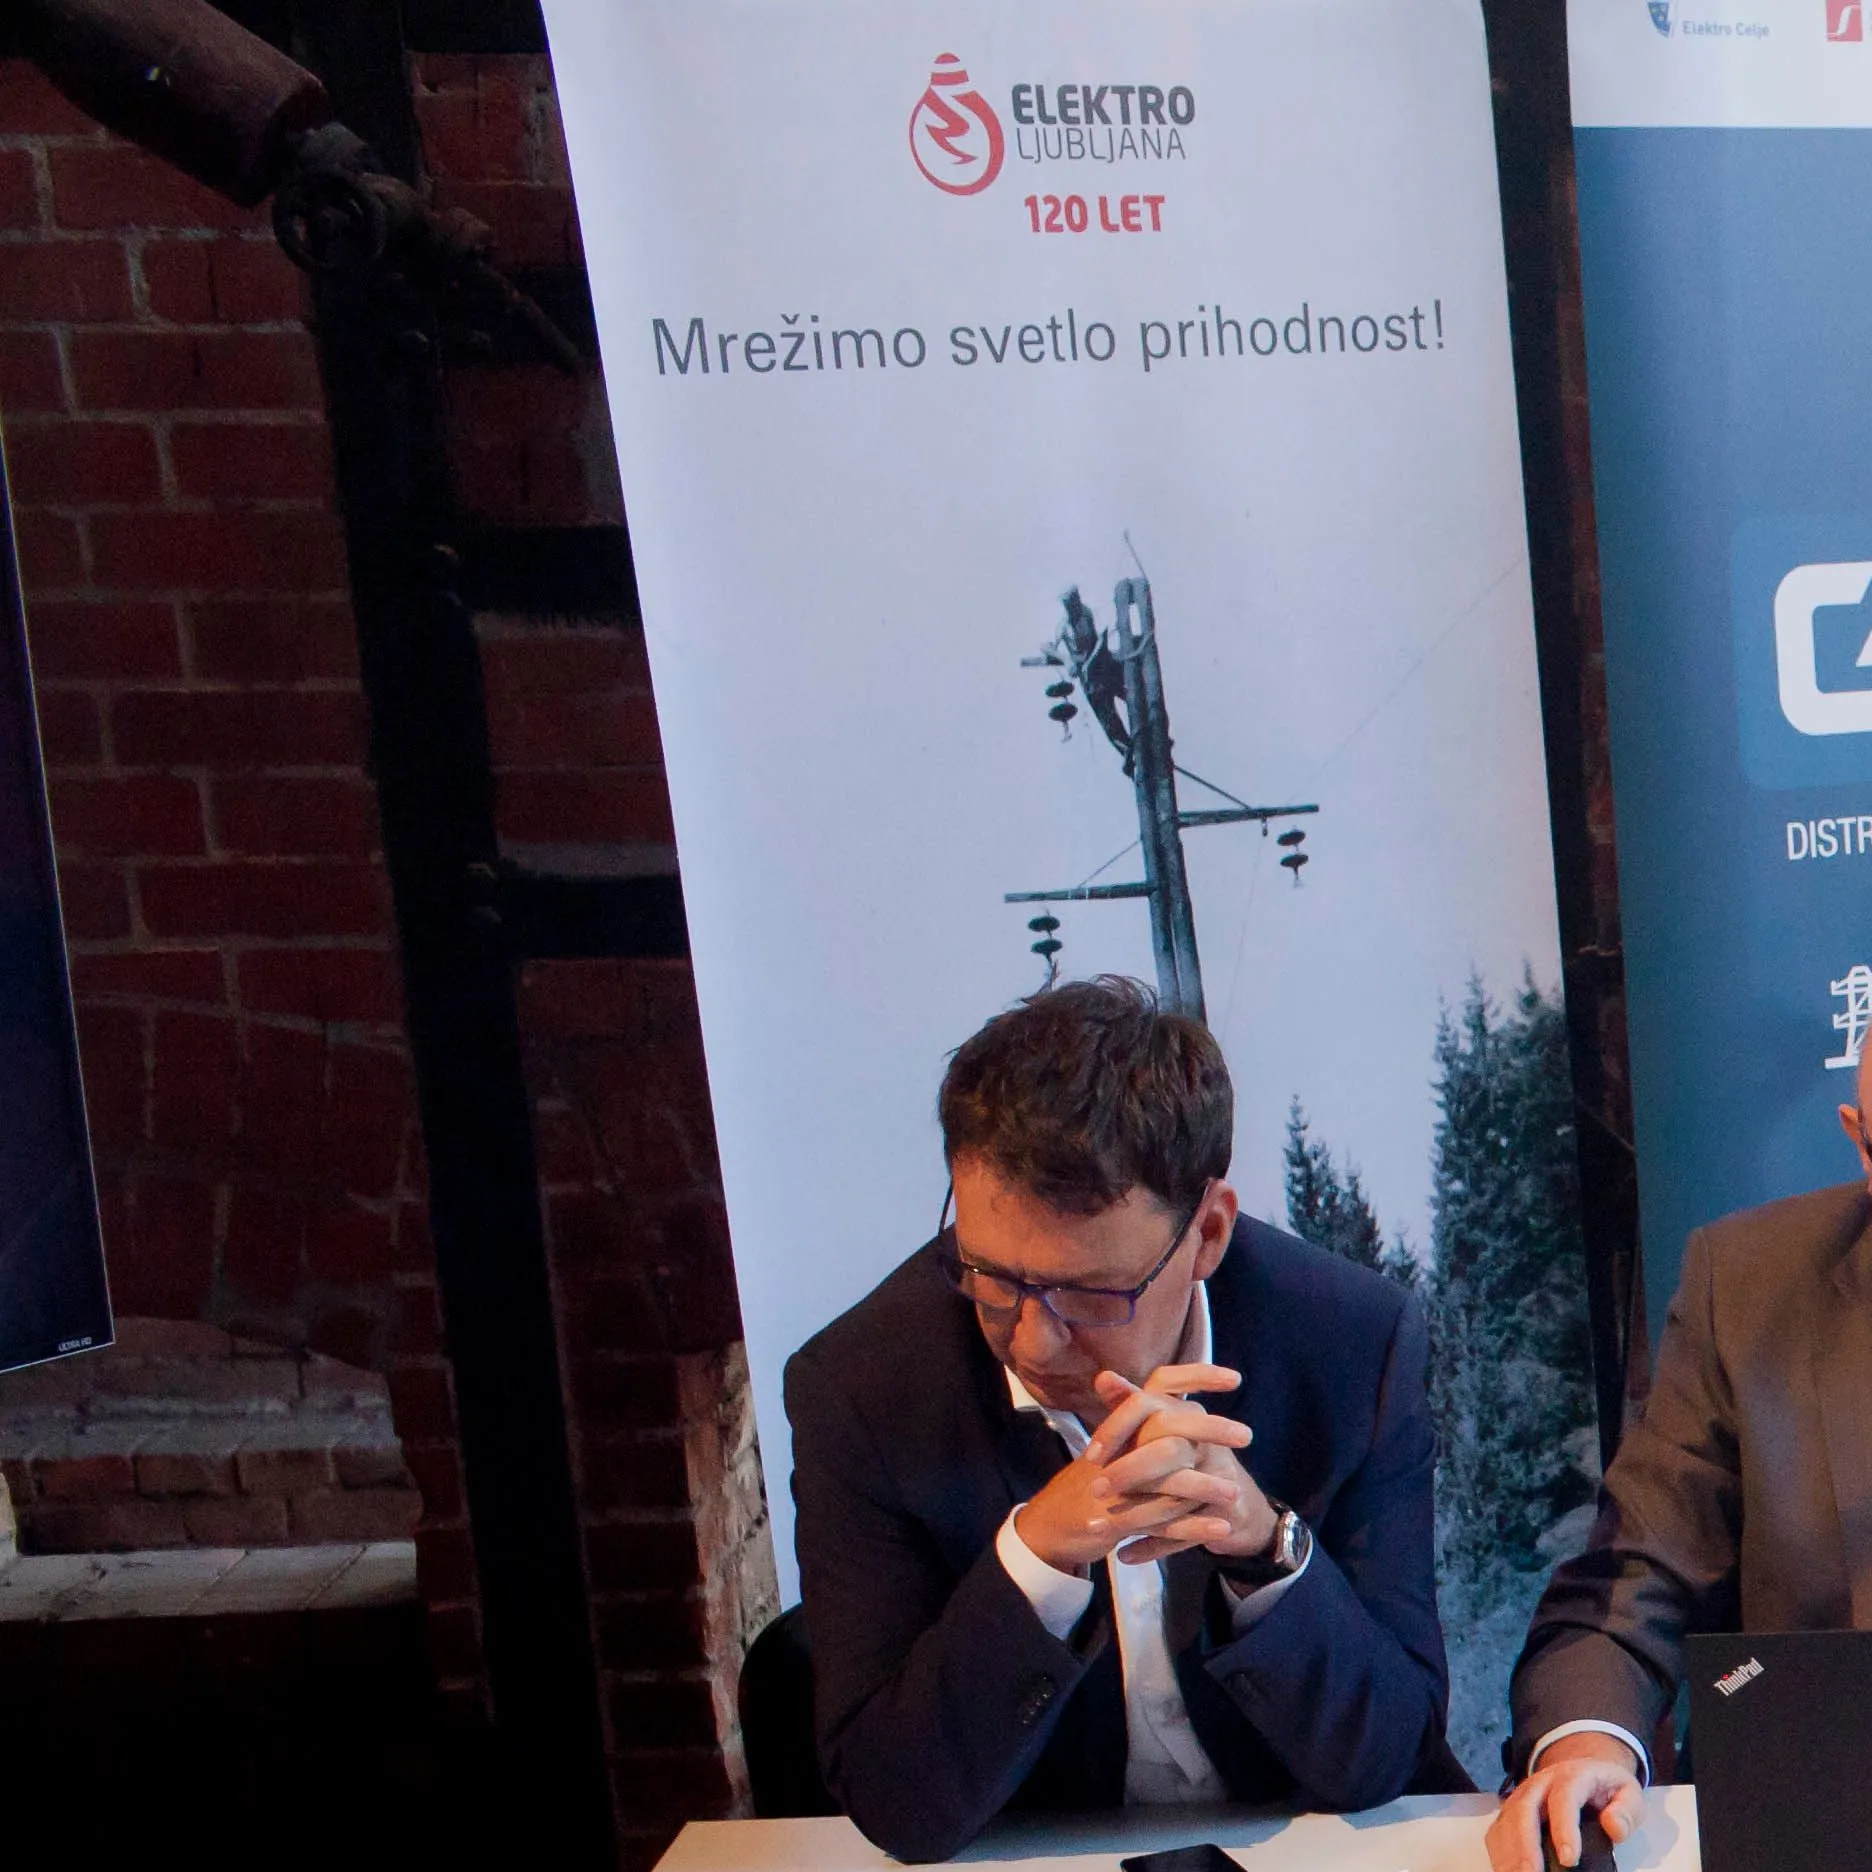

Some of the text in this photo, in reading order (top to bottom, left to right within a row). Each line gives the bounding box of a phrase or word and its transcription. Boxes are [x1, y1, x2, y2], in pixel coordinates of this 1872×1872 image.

[1682, 20, 1732, 35] Elektro
[1011, 83, 1195, 127] ELEKTRO
[1016, 126, 1187, 165] LJUBLJANA
[1024, 194, 1166, 235] 120 LET
[651, 299, 1447, 376] Mrežimo svetlo prihodnost!
[1713, 1657, 1765, 1697] ThinkPad
